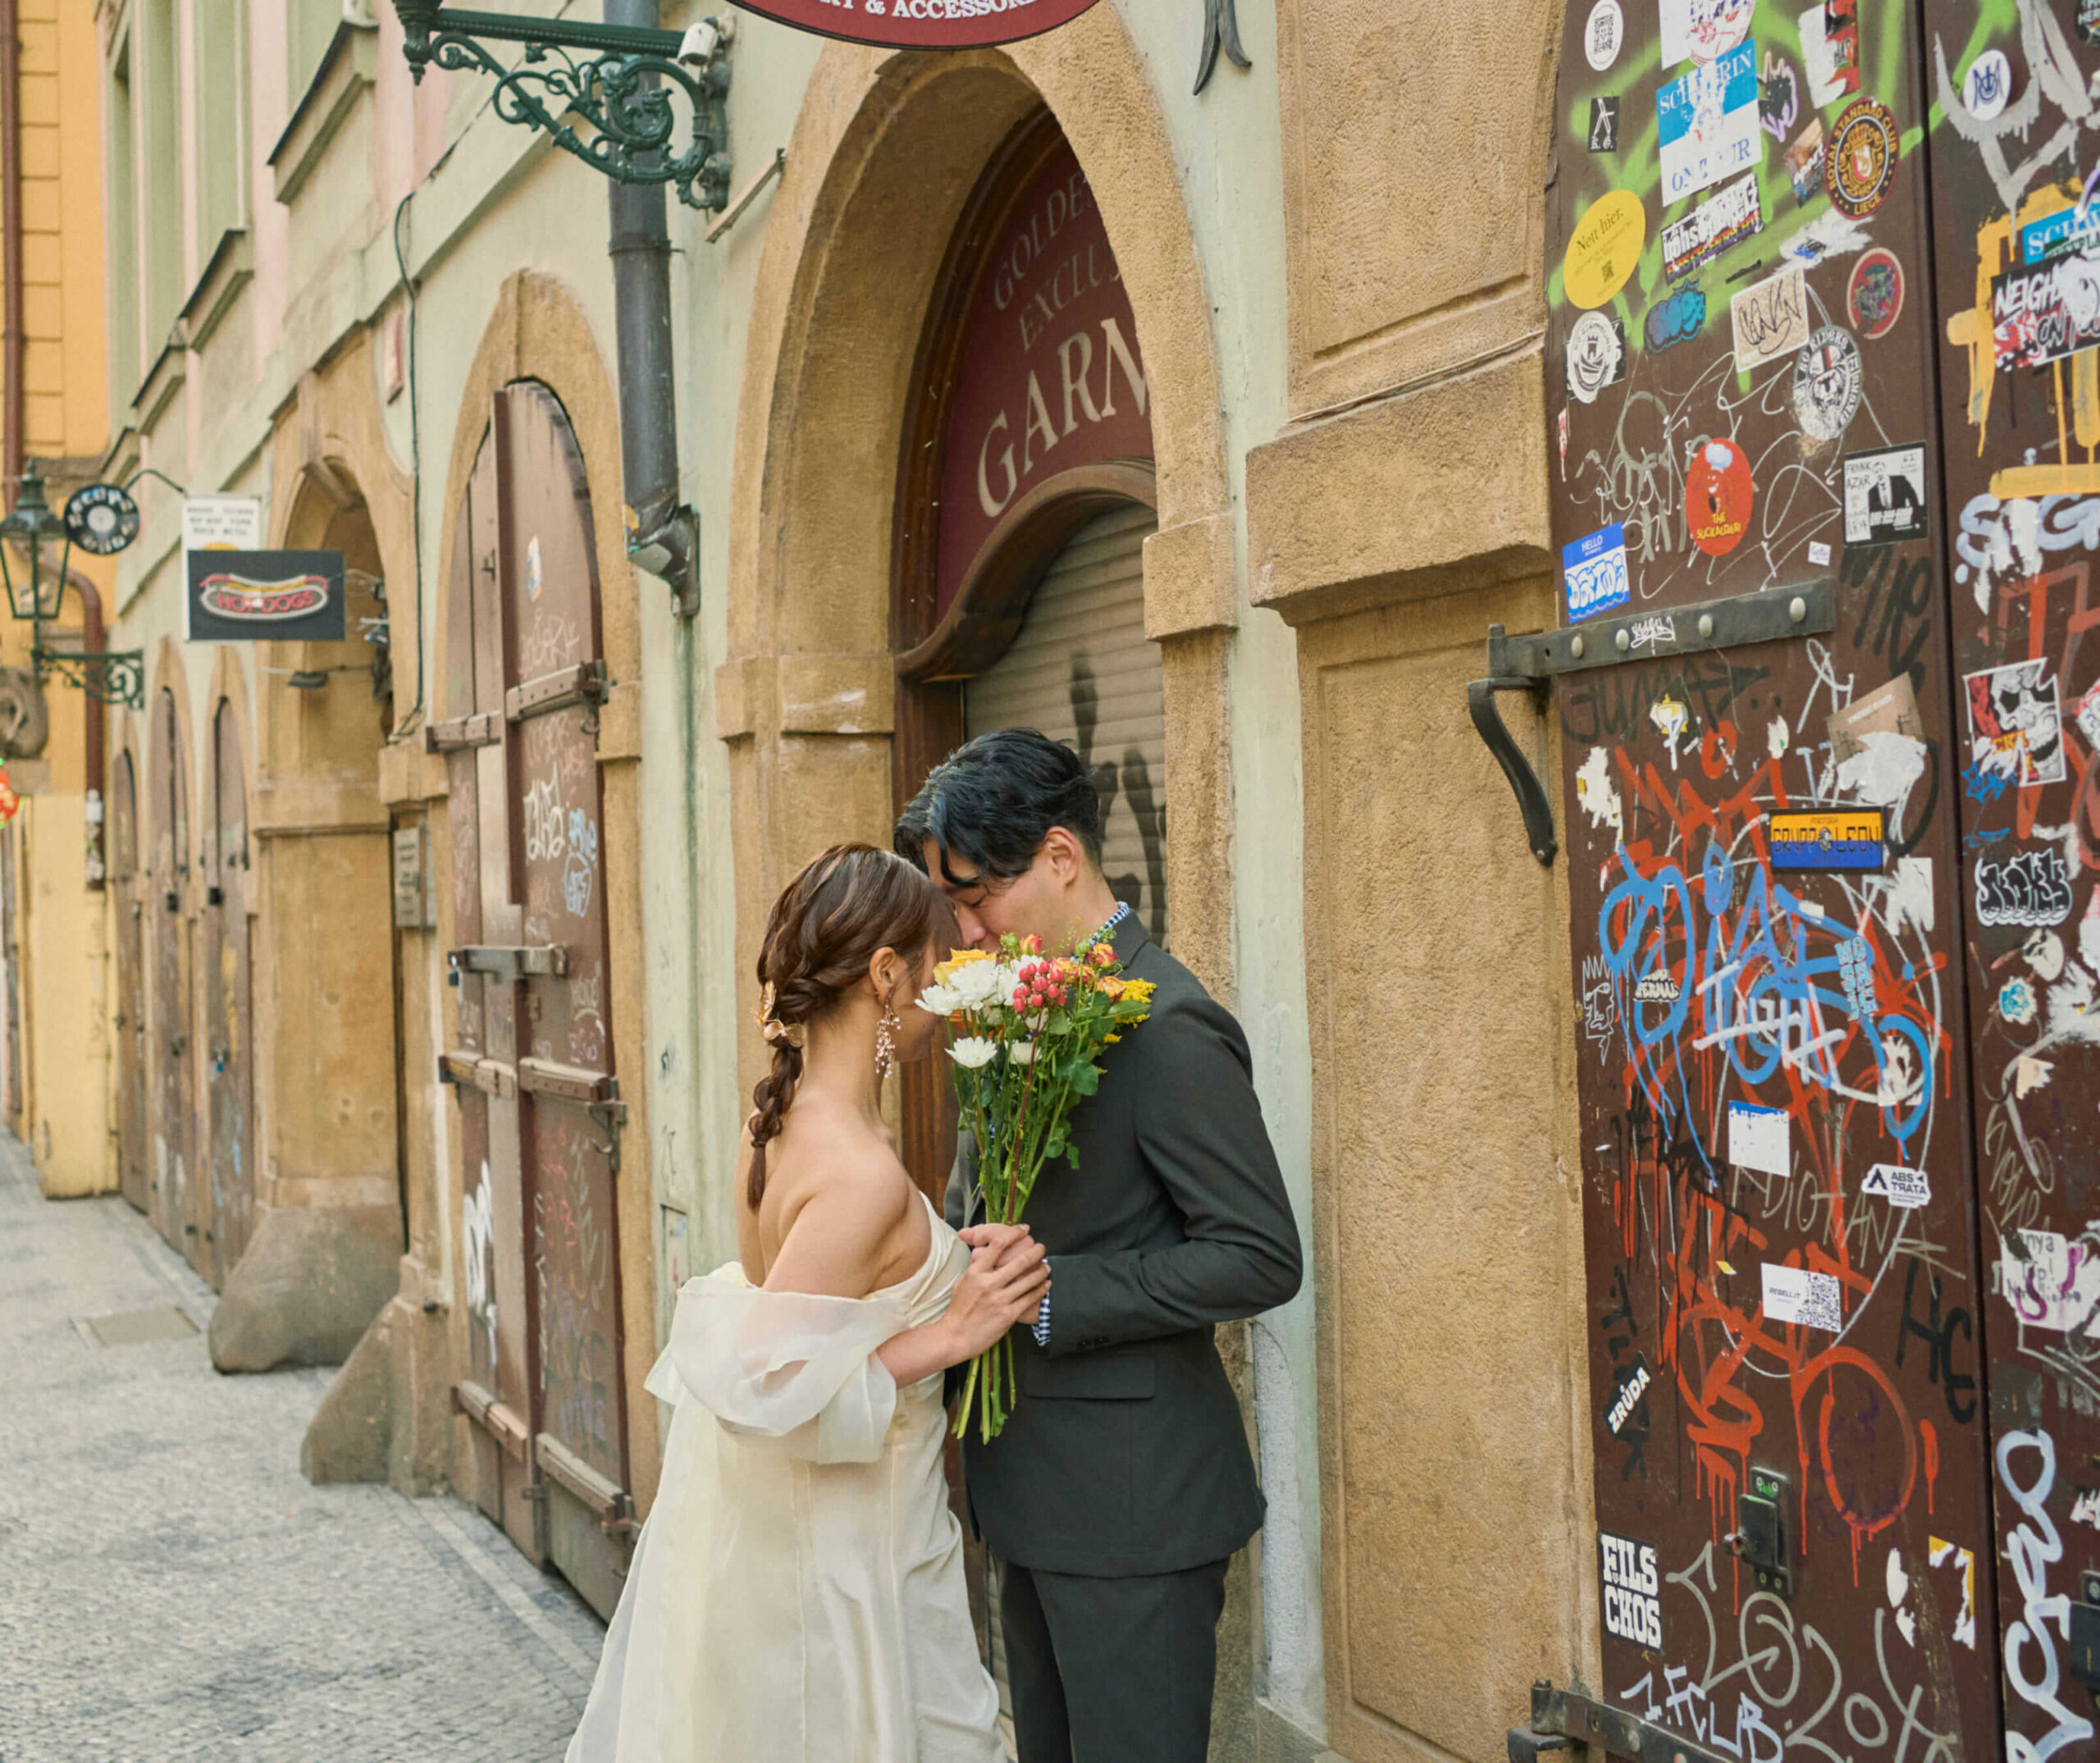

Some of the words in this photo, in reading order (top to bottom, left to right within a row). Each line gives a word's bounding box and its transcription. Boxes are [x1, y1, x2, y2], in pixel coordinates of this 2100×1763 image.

[892, 0, 1037, 20] ACCESSO
[1659, 49, 1753, 116] SCRIN
[1883, 116, 1897, 153] CLUB
[994, 169, 1096, 311] GOLDE
[1577, 229, 1599, 257] Nett
[1712, 511, 1727, 525] THE
[1582, 535, 1604, 552] HELLO
[217, 591, 255, 614] HOT
[261, 590, 314, 614] DOGS
[1891, 1172, 1915, 1183] ABS
[1604, 1583, 1662, 1650] CKOS
